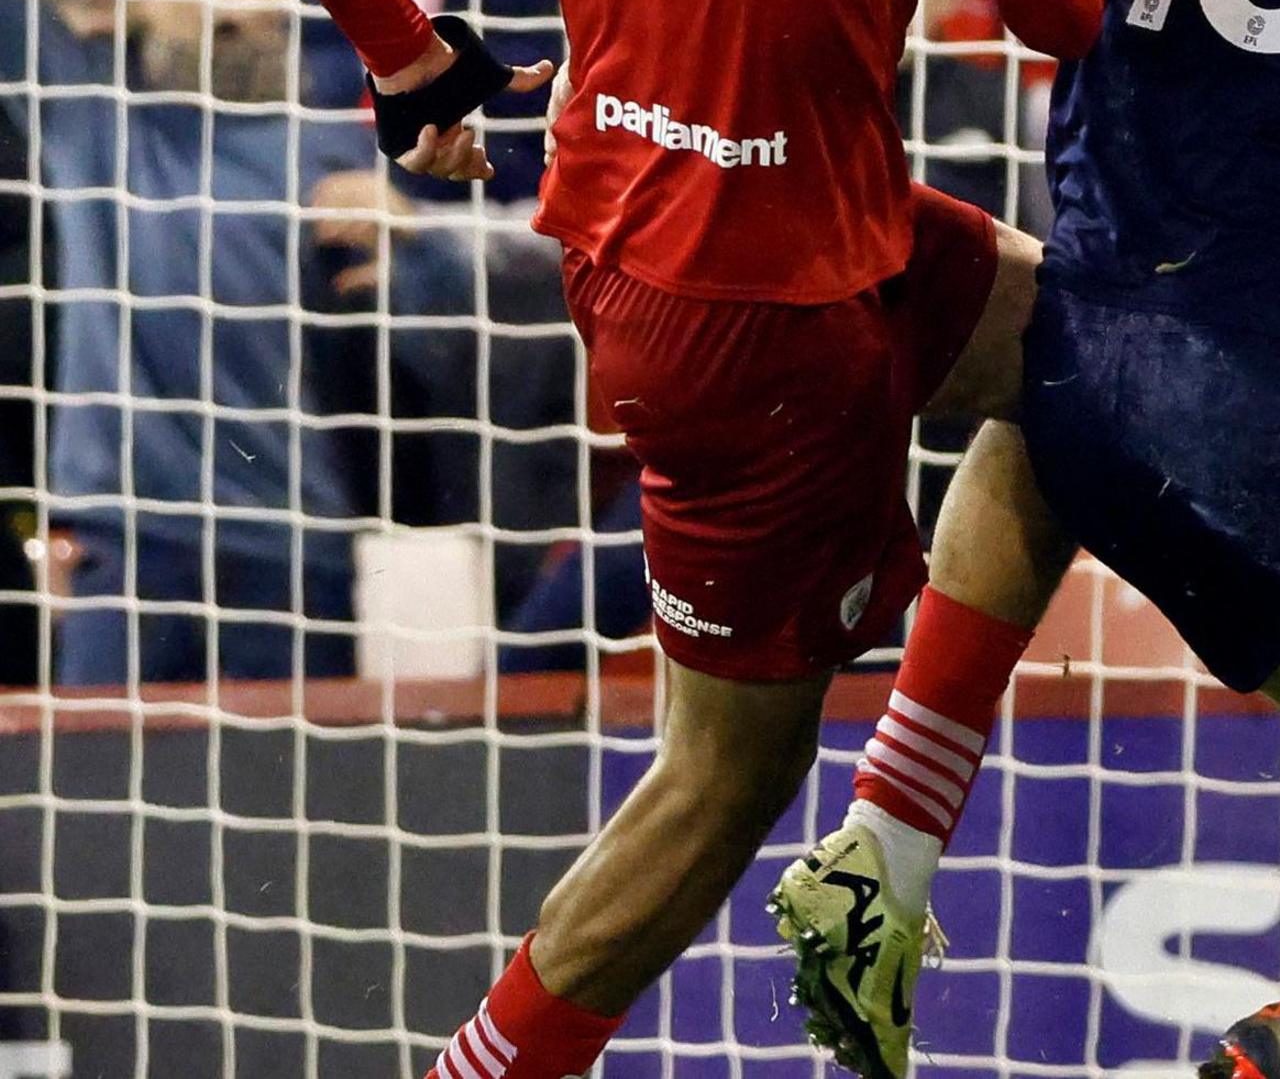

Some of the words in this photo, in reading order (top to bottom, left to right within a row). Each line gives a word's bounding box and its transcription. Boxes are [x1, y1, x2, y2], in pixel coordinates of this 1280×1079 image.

[595, 93, 788, 168] parliament
[651, 578, 694, 615] RAPID
[651, 590, 733, 637] RESPONSE
